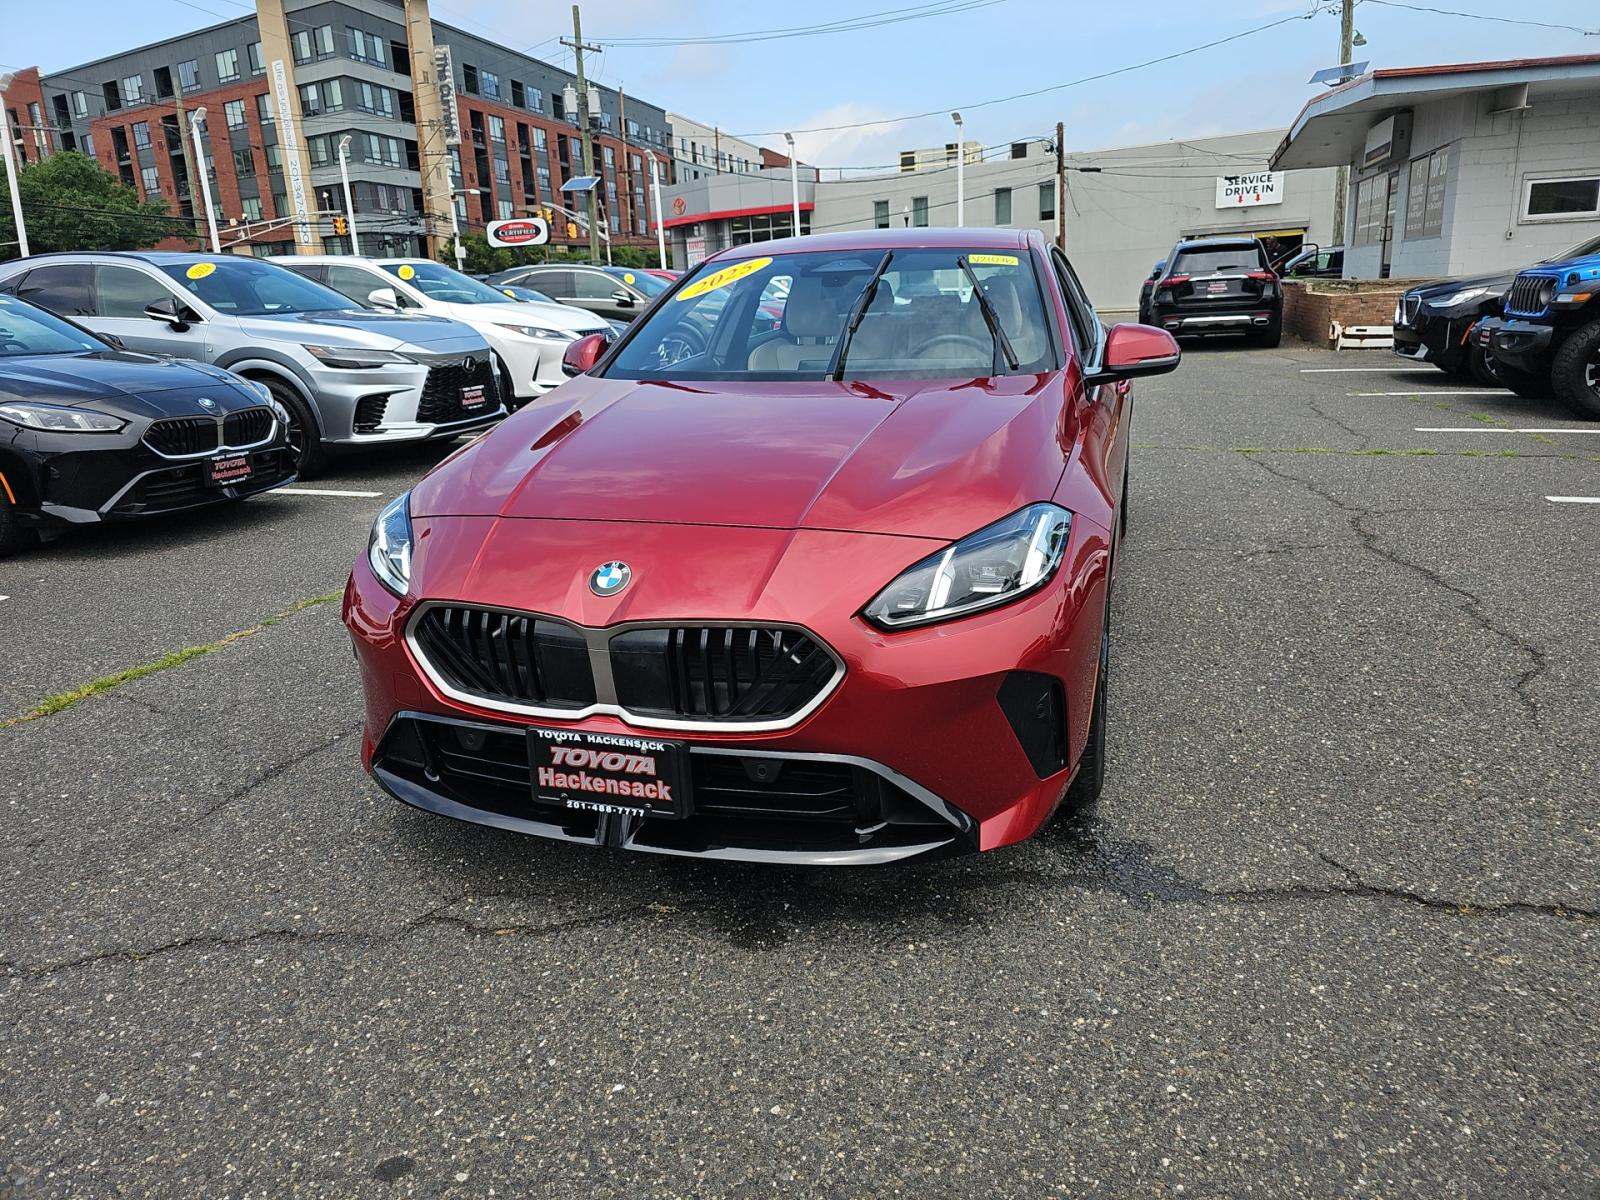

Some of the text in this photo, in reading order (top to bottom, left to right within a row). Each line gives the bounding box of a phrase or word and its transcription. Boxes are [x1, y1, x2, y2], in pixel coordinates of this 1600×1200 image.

[435, 54, 447, 81] The
[1225, 184, 1274, 196] DRIVE IN
[1228, 174, 1273, 186] SERVICE
[215, 458, 246, 470] TOYOTA
[537, 730, 665, 751] TOYOTA HACKENSACK
[550, 746, 657, 776] TOYOTA
[538, 767, 673, 801] Hackensack
